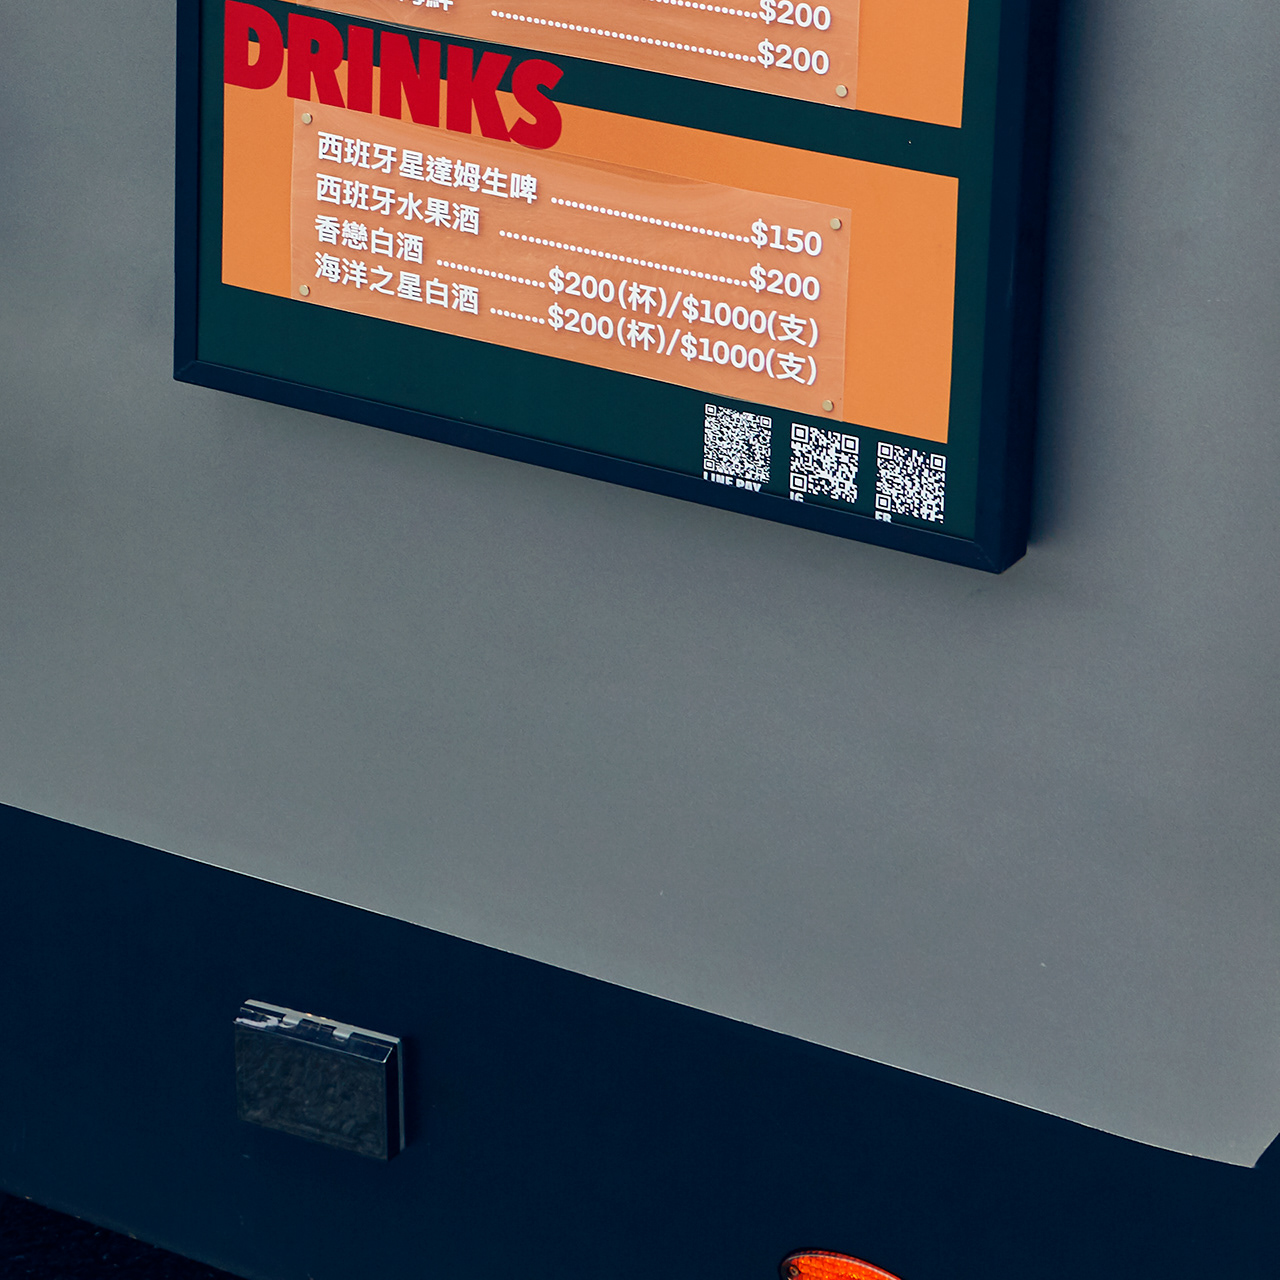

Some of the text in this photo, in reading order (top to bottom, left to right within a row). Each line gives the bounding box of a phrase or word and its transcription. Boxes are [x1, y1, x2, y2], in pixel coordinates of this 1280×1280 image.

[223, 0, 564, 151] DRINKS
[757, 38, 830, 75] $200
[315, 214, 424, 265] 香戀白酒
[316, 172, 821, 301] 西班牙水果酒 $200
[317, 130, 823, 257] 西班牙星達姆生啤 $150
[314, 251, 479, 316] 海洋之星白酒
